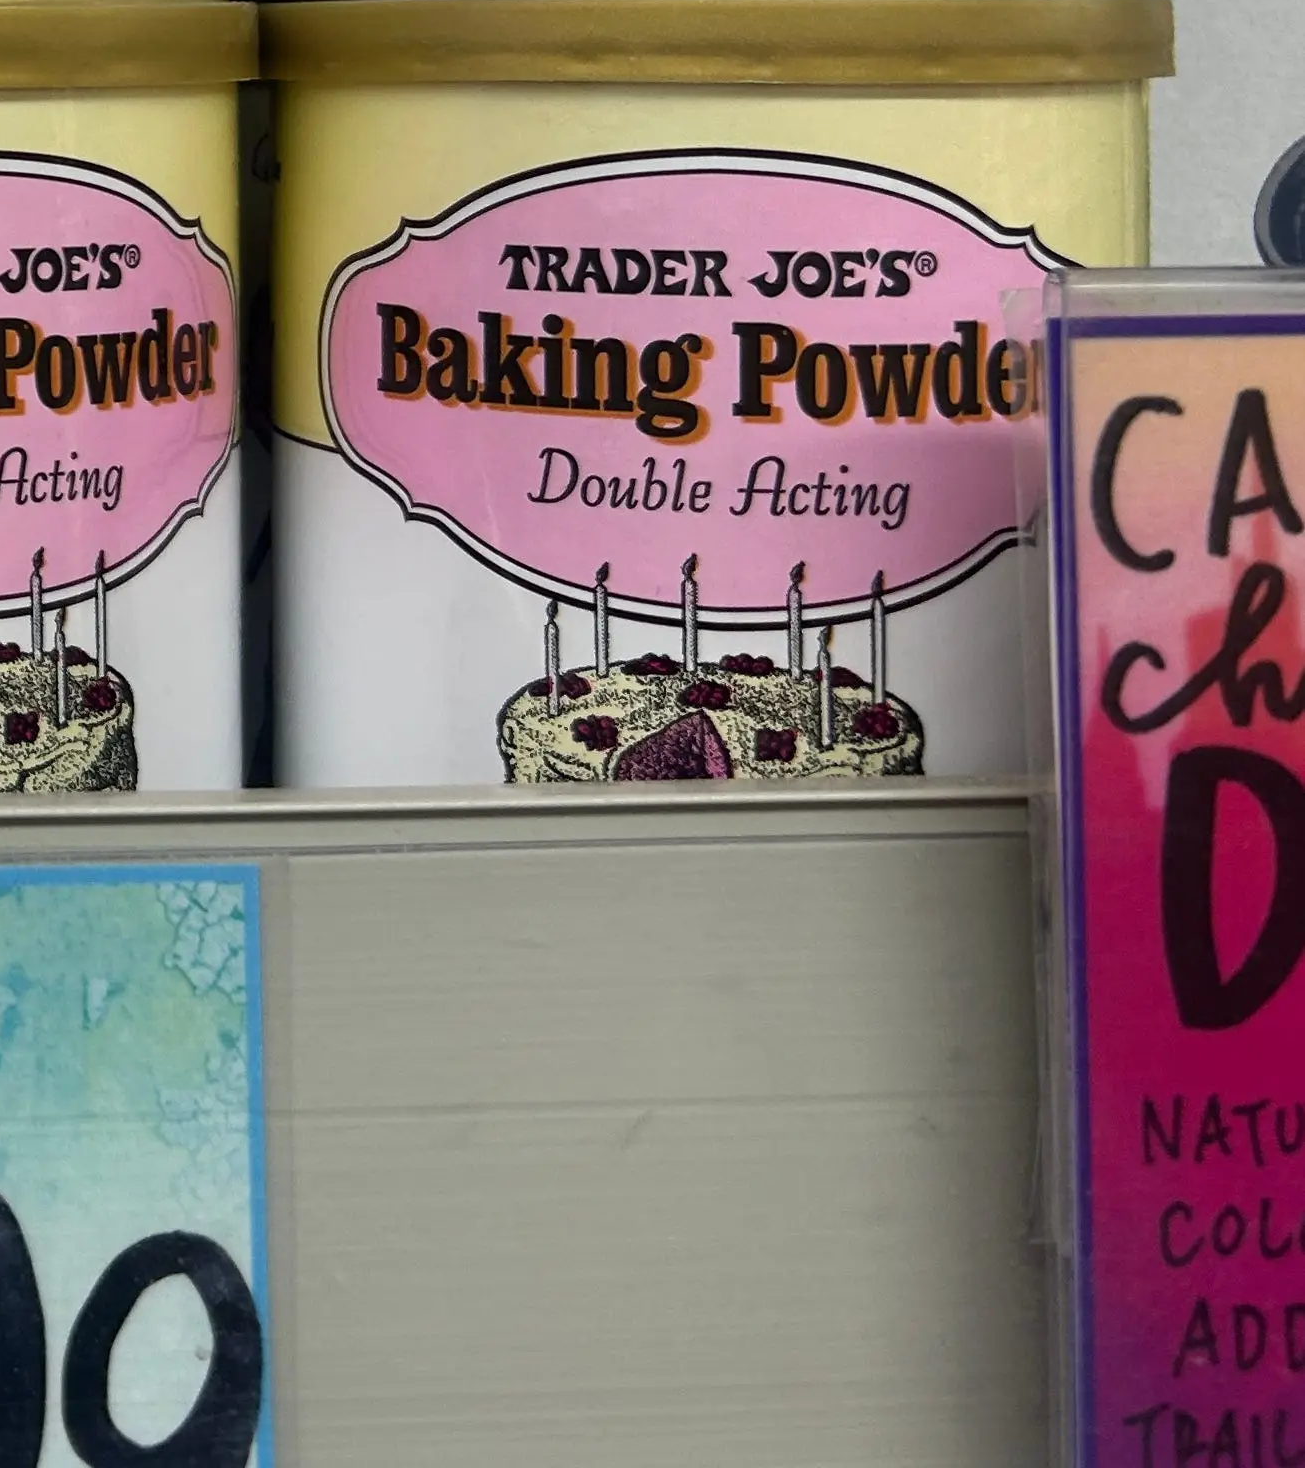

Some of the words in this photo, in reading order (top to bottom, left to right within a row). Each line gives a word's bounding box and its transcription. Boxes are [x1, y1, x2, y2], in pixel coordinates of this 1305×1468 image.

[498, 244, 733, 299] TRADER
[376, 302, 710, 442] Baking
[527, 446, 711, 515] Double
[729, 455, 911, 530] Acting
[1160, 1196, 1305, 1268] COL
